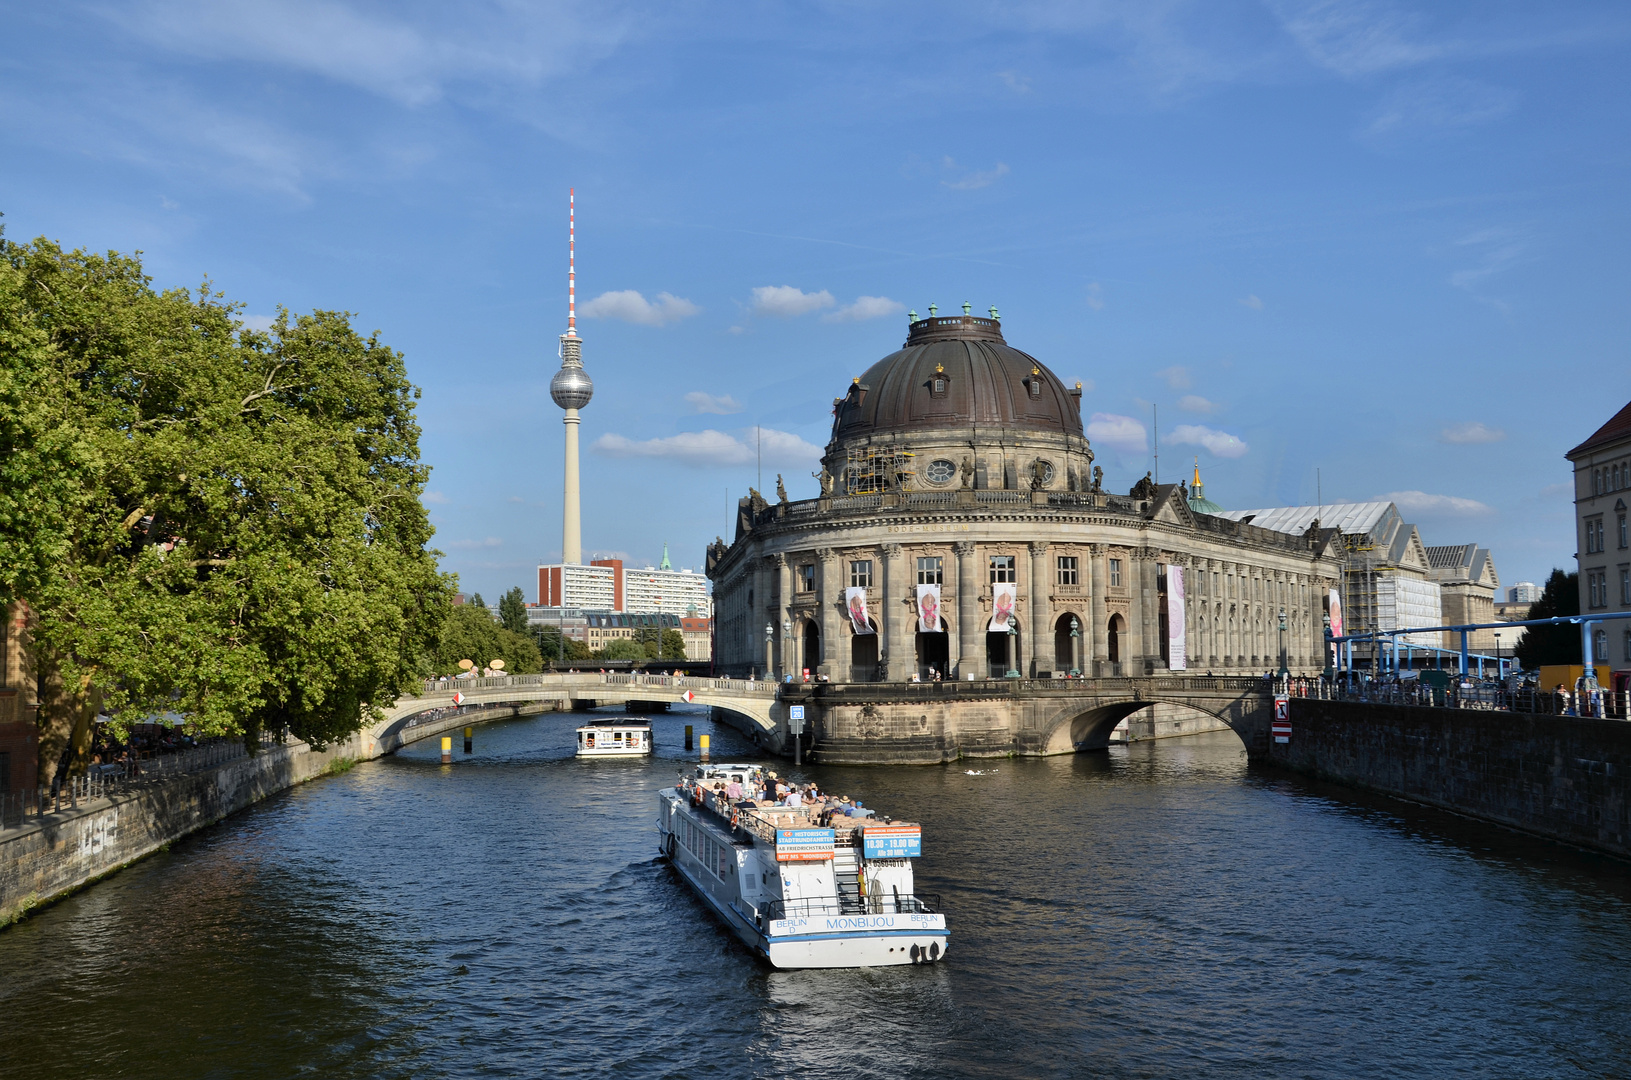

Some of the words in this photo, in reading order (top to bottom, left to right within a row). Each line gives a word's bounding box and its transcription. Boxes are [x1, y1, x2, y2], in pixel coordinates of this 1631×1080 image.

[888, 524, 969, 532] BODE-MUSEUM
[776, 919, 807, 928] BERLIN
[826, 917, 894, 929] MONBIJOU
